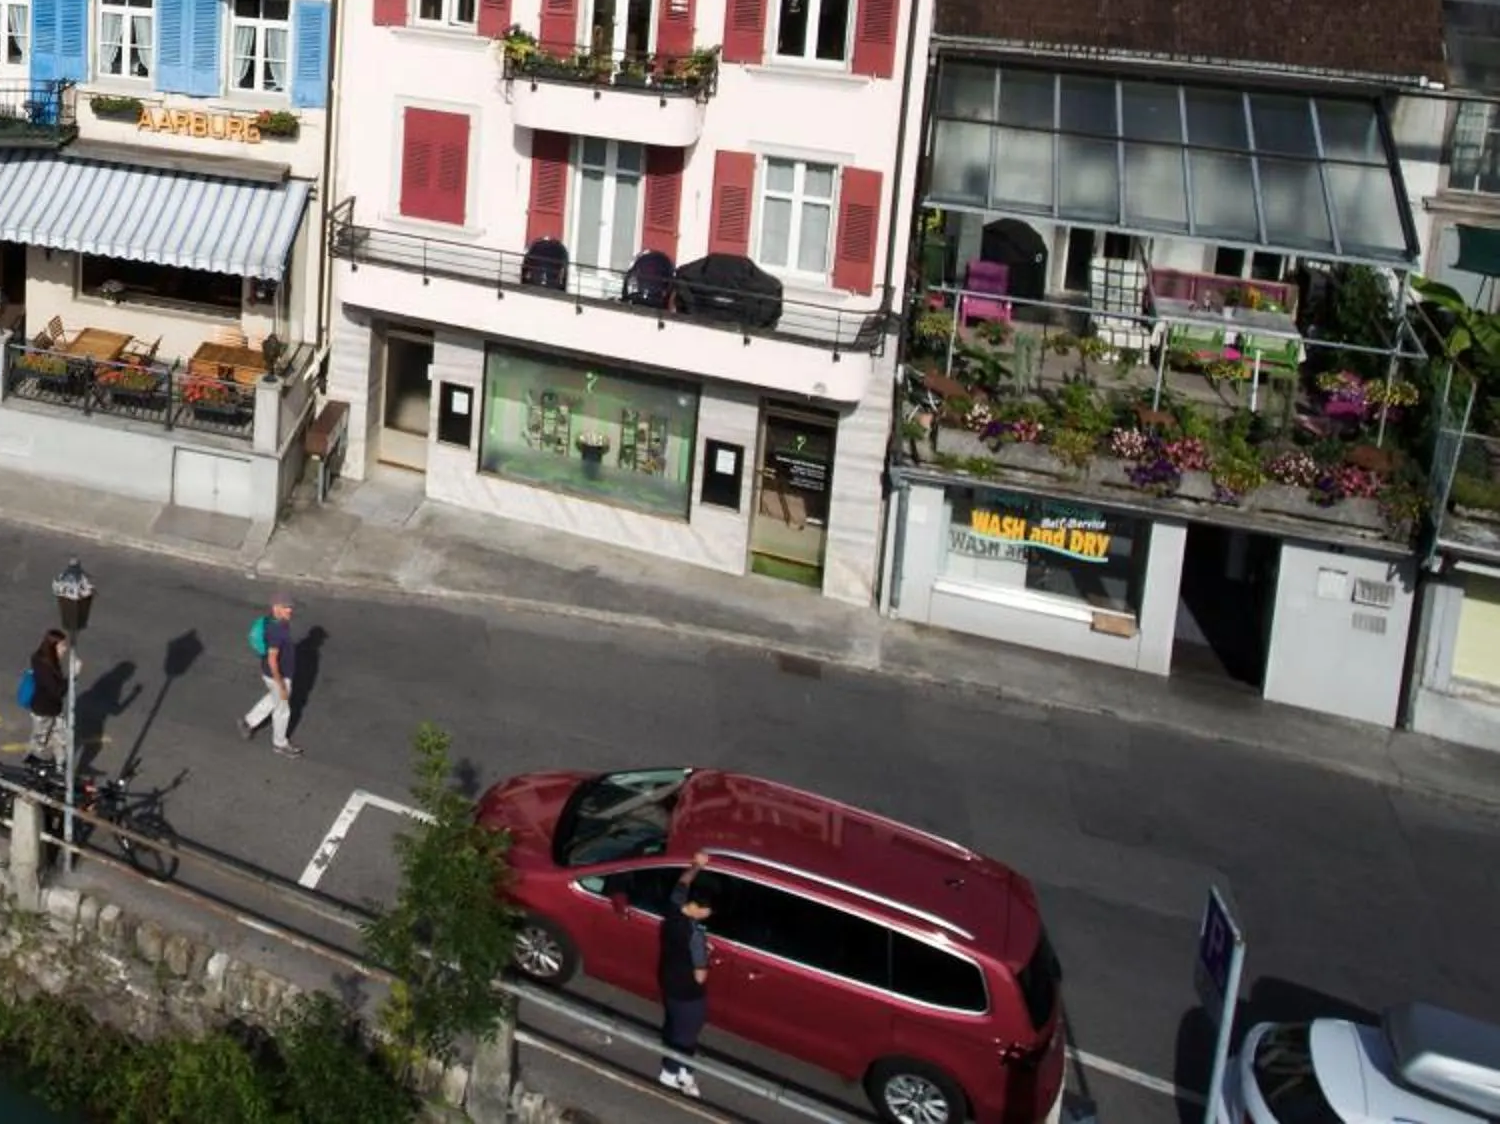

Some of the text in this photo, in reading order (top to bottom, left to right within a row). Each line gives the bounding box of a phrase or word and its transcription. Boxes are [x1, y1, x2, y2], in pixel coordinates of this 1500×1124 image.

[137, 106, 261, 144] AARBURG
[971, 507, 1111, 558] WASH and DRY
